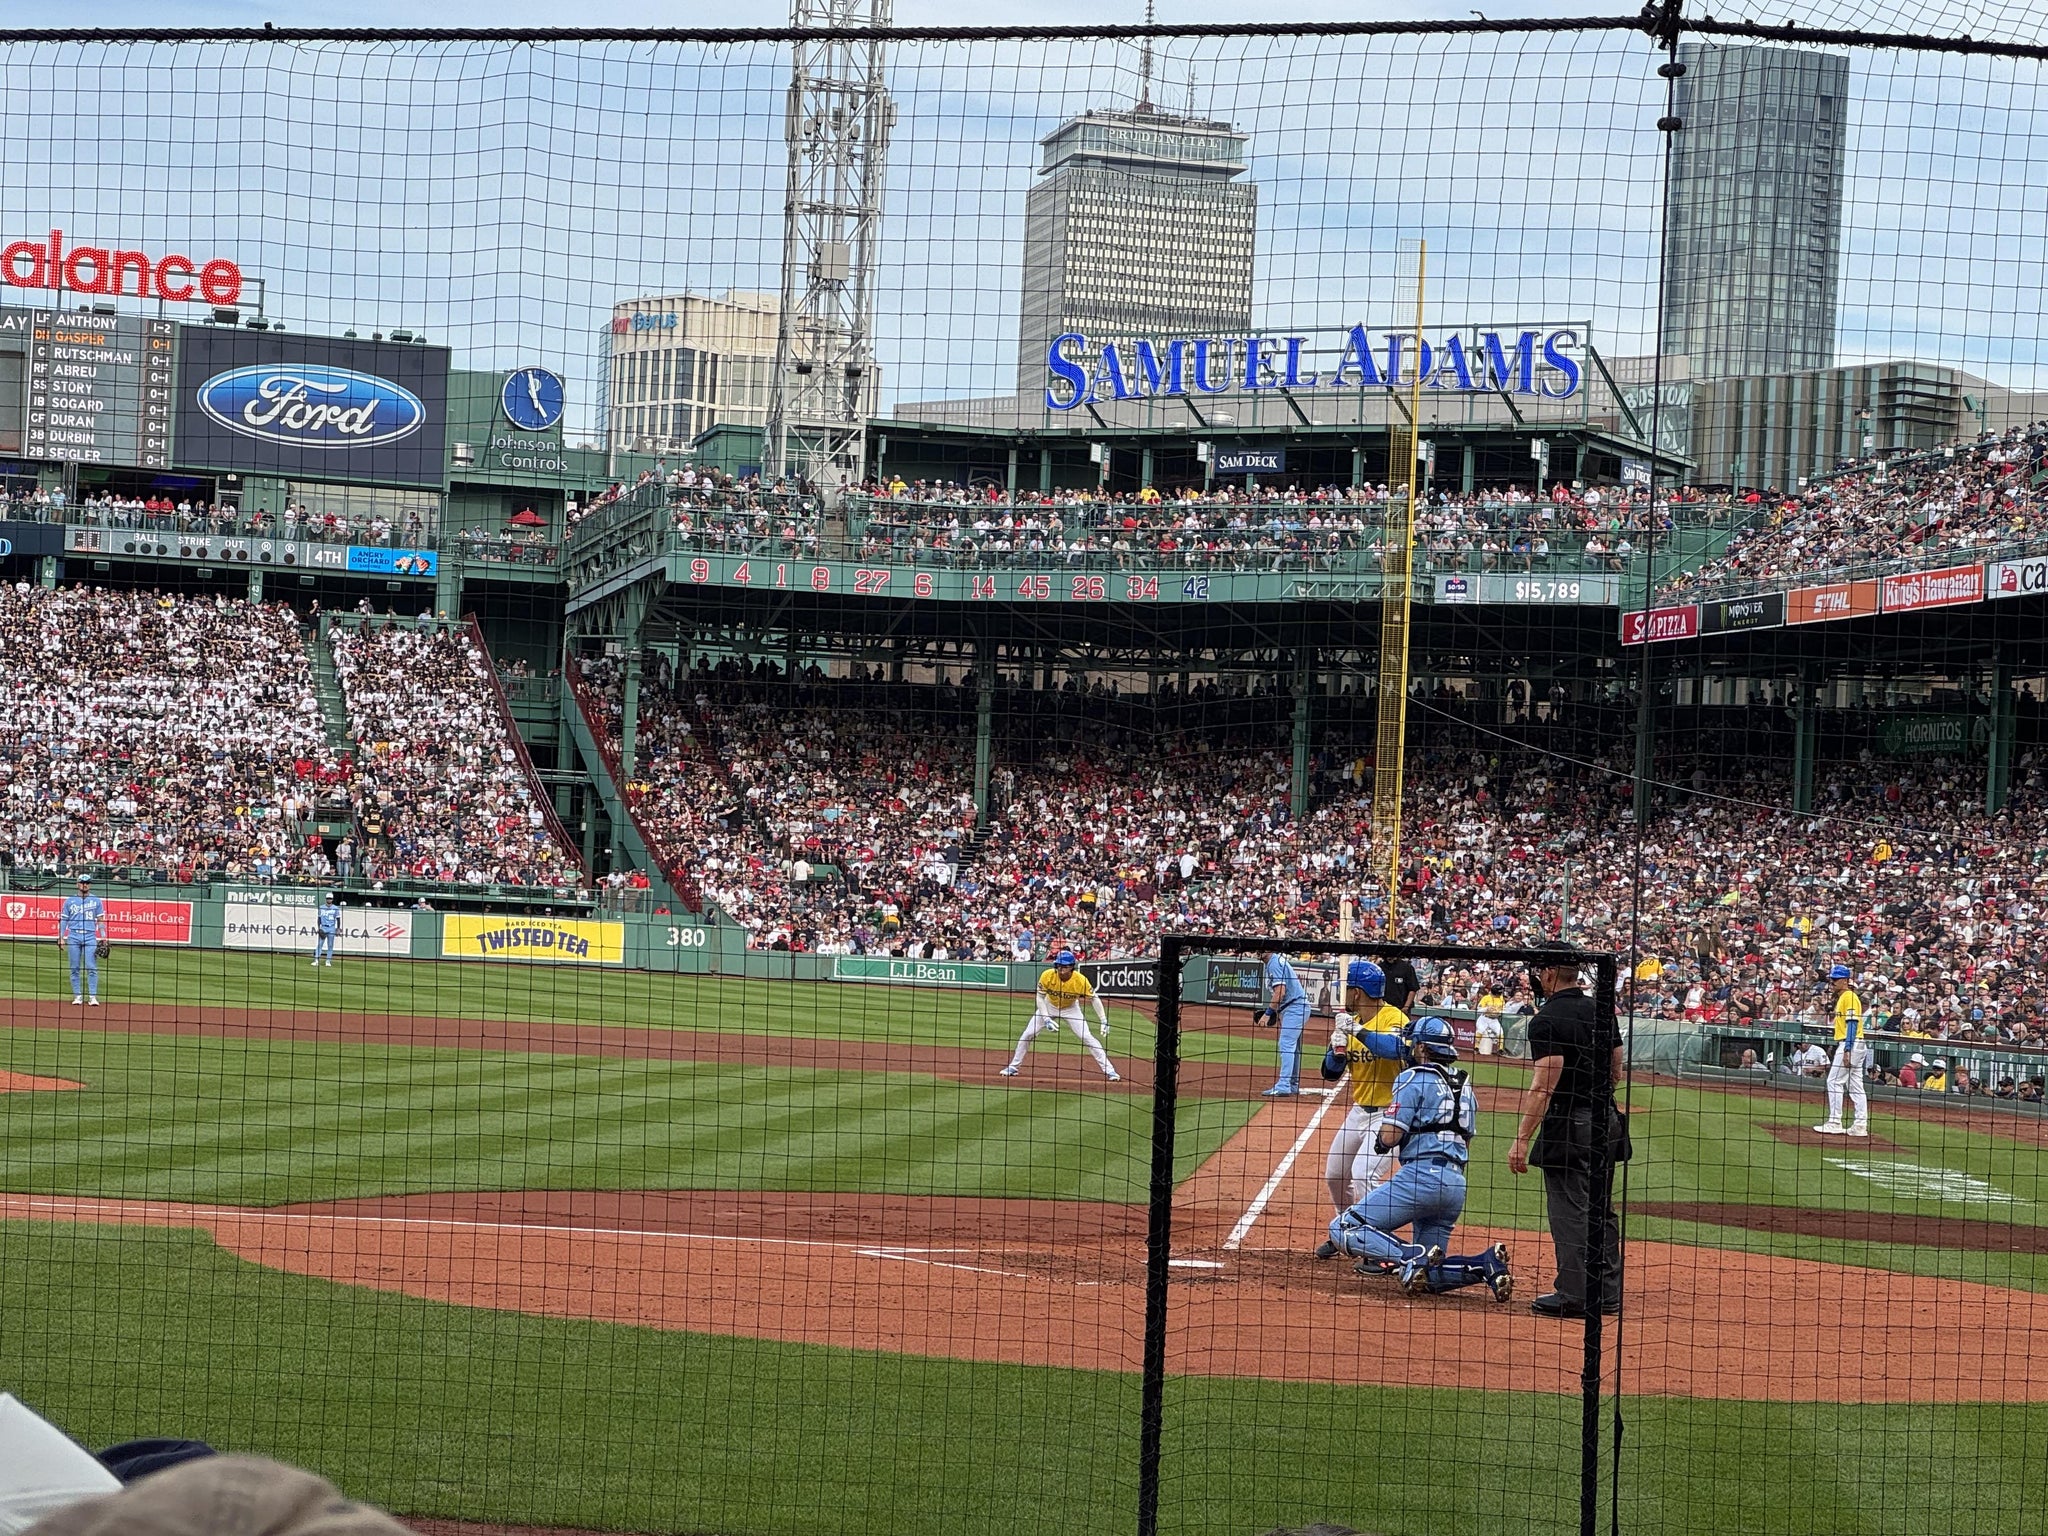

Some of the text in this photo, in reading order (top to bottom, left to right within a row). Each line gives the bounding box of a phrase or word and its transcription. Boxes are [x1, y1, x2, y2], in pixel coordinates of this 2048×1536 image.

[1109, 128, 1218, 148] PRUDENTIAL
[1, 229, 242, 305] alance
[56, 314, 118, 330] ANTHONY
[55, 331, 105, 345] GASPER
[54, 347, 132, 364] RUTSCHMAN
[53, 365, 97, 378] ABREU
[1046, 321, 1584, 410] SAMUEL ADAMS
[53, 381, 92, 394] STORY
[52, 398, 103, 411] SOGARD
[243, 375, 381, 435] Ford
[1623, 385, 1689, 409] BOSTON
[51, 414, 94, 428] DURAN
[50, 430, 95, 445] DURBIN
[490, 431, 556, 451] Johnson
[501, 453, 568, 471] Controls
[1219, 455, 1277, 468] SAM DECK
[134, 533, 159, 543] BALL
[178, 536, 212, 546] STRIKE
[225, 540, 244, 549] OUT
[314, 551, 341, 564] 4TH
[45, 570, 54, 578] 42
[690, 558, 1210, 600] 9 4 1 8 27 6 14 45 26 34 42
[1516, 581, 1580, 602] $15,789
[1885, 573, 1980, 607] King's Hawaiian
[1814, 591, 1850, 613] STIHL
[1657, 614, 1687, 637] PIZZA
[1733, 618, 1758, 626] ENERGY
[1905, 721, 1962, 743] HORNITOS
[284, 894, 305, 903] HOUSE
[306, 895, 315, 903] OF
[29, 908, 61, 919] Harva
[119, 909, 157, 923] Health
[158, 912, 185, 924] Care
[109, 926, 138, 935] company
[229, 923, 271, 935] BANK
[276, 925, 296, 935] OF
[667, 927, 705, 947] 380
[476, 928, 589, 958] TWISTED TEA
[1094, 965, 1154, 994] jordan's
